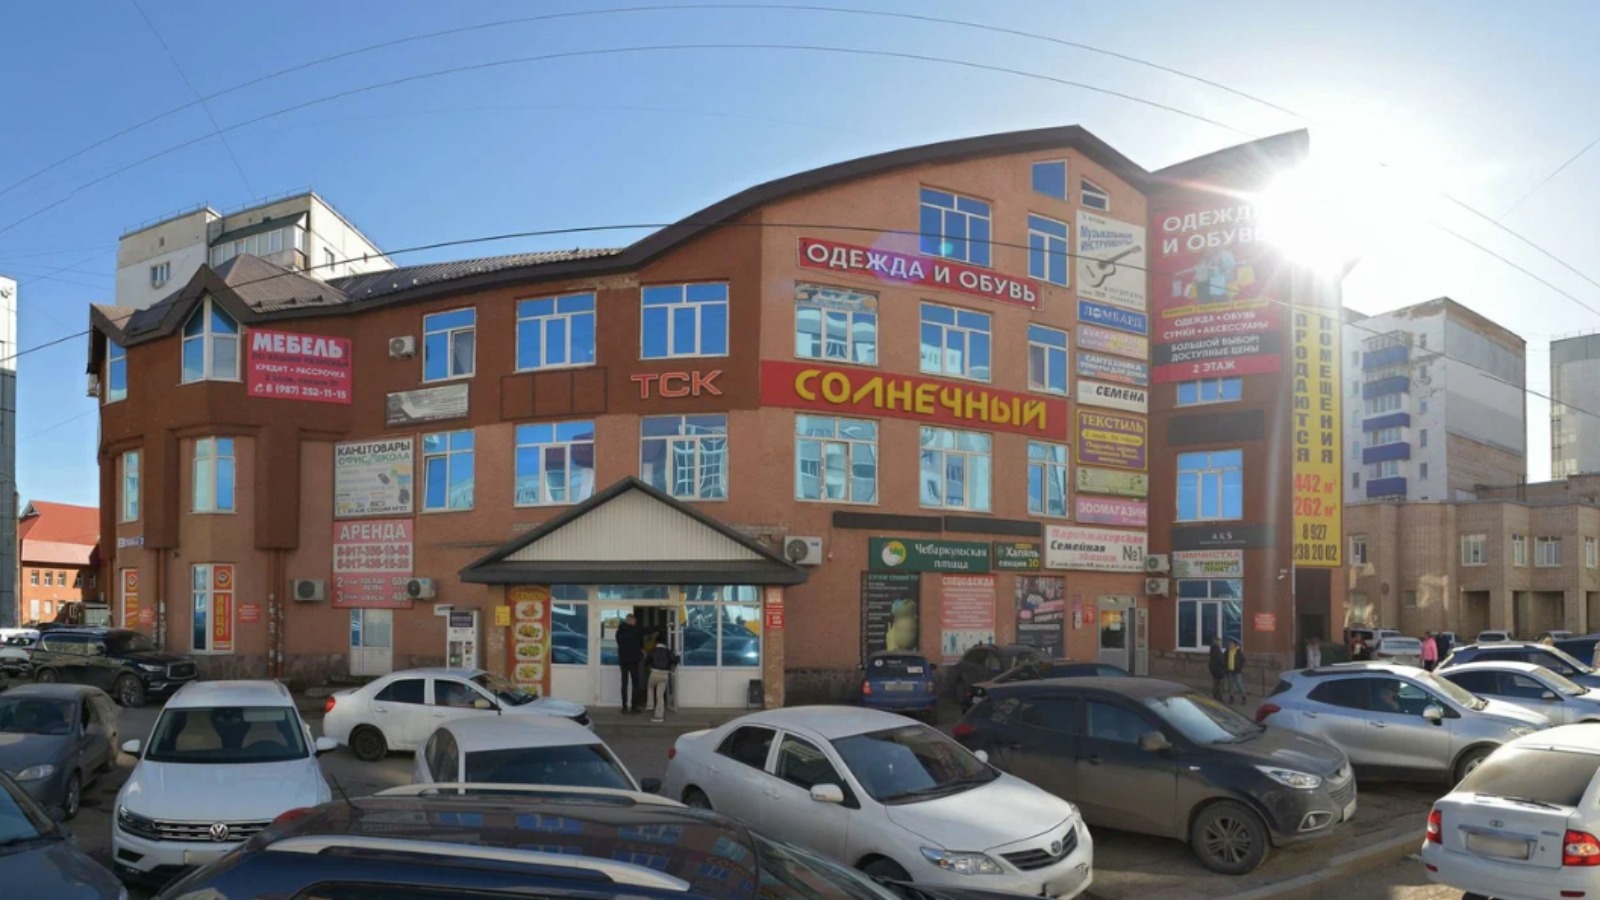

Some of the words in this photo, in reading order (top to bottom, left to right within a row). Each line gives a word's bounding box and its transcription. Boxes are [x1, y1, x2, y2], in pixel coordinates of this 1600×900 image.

[1162, 204, 1258, 233] ОДЕЖД
[1163, 238, 1179, 255] И
[807, 243, 925, 280] ОДЕЖДА
[934, 265, 950, 284] И
[959, 271, 1036, 303] ОБУВЬ
[1174, 315, 1215, 328] ОДЕЖДА
[1223, 311, 1256, 321] ОБУВЬ
[1163, 330, 1196, 340] СУМКИ
[1203, 321, 1269, 335] АКСЕССУАРЫ
[252, 332, 343, 359] МЕБЕЛЬ
[1171, 338, 1219, 352] БОЛЬШОЙ
[1171, 348, 1228, 363] ДОСТУПНЫЕ
[1231, 345, 1260, 354] ЦЕНЫ
[255, 363, 288, 374] КРЕДИТ
[1193, 365, 1200, 373] 2
[1202, 361, 1236, 372] ЭТАЖ
[630, 370, 723, 399] ТСК
[1295, 313, 1310, 462] ПРОДАЮТСЯ
[1320, 316, 1333, 464] ПОМЕЩЕНИЯ
[794, 370, 1047, 430] СОЛНЕЧНЫЙ
[1096, 385, 1145, 403] СЕМЕНА
[1081, 413, 1144, 433] ТЕКСТИЛЬ
[337, 441, 410, 457] КАНЦТОВАРЫ
[1079, 502, 1147, 519] ЗООМАГАЗИН
[1294, 497, 1322, 517] 262
[340, 523, 406, 541] АРЕНДА
[1302, 523, 1309, 540] 8
[1310, 523, 1327, 541] 927
[914, 543, 987, 558] Чебаркульская
[1050, 540, 1106, 553] Семейная
[1122, 545, 1143, 562] №1
[1311, 544, 1324, 561] 20
[1325, 545, 1337, 561] 02
[934, 560, 969, 570] птица
